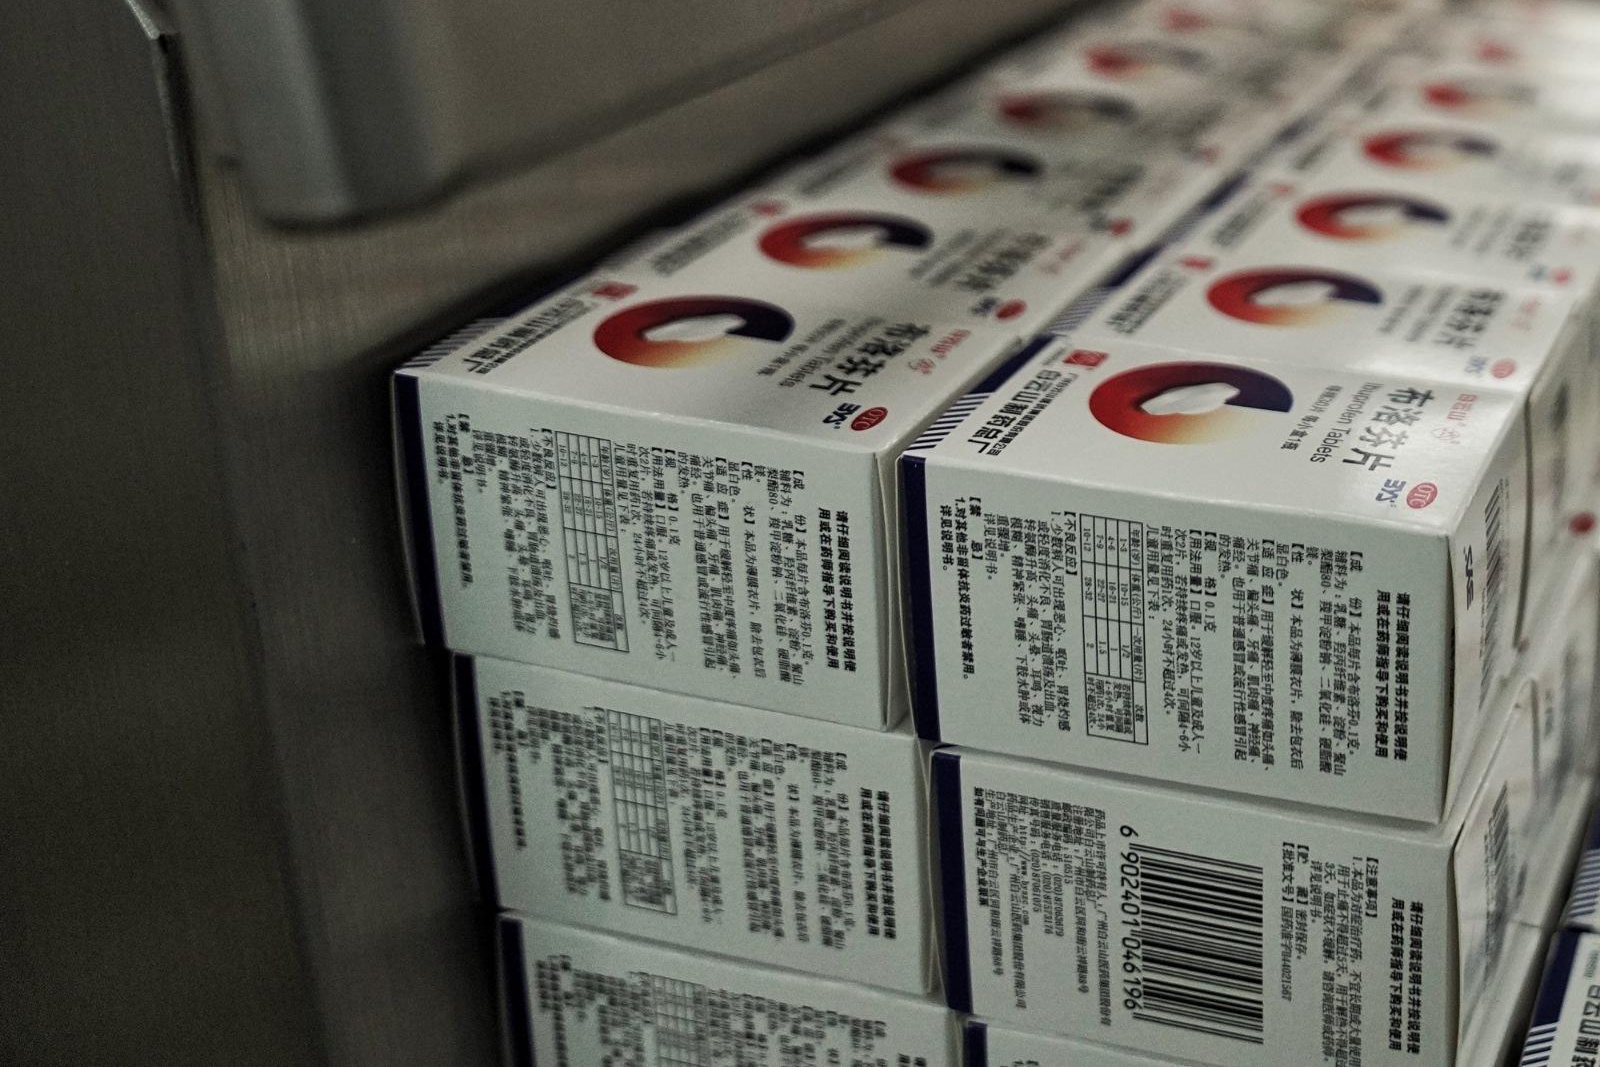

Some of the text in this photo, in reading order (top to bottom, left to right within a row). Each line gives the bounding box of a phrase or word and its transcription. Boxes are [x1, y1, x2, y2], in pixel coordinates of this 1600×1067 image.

[809, 323, 931, 396] 布洛芬片
[852, 407, 888, 431] OTC
[968, 369, 1062, 454] 白云山制药总厂
[1310, 382, 1385, 463] Ibuprofen Tablets
[1342, 387, 1435, 471] 布洛芬片
[1407, 483, 1437, 509] OTC
[939, 504, 954, 572] 详见说明书。
[983, 512, 998, 581] 详见说明书。
[1063, 510, 1077, 575] 【不良反应】
[1217, 533, 1230, 579] 的发热。
[1275, 542, 1288, 588] 显白色。
[817, 507, 839, 669] 用或在药师指导下购买和使用
[835, 509, 856, 672] 请仔细阅读说明书并按说明使
[1374, 588, 1390, 758] 用或在药师指导下购买和使用
[1393, 591, 1409, 761] 请仔细阅读说明书并按说明使
[1119, 824, 1142, 1012] 6 902401 046196
[1364, 856, 1378, 918] 【注意事项】
[1388, 897, 1404, 1051] 用或在药师指导下购买和使用
[1406, 900, 1422, 1054] 请仔细阅读说明书并按说明使
